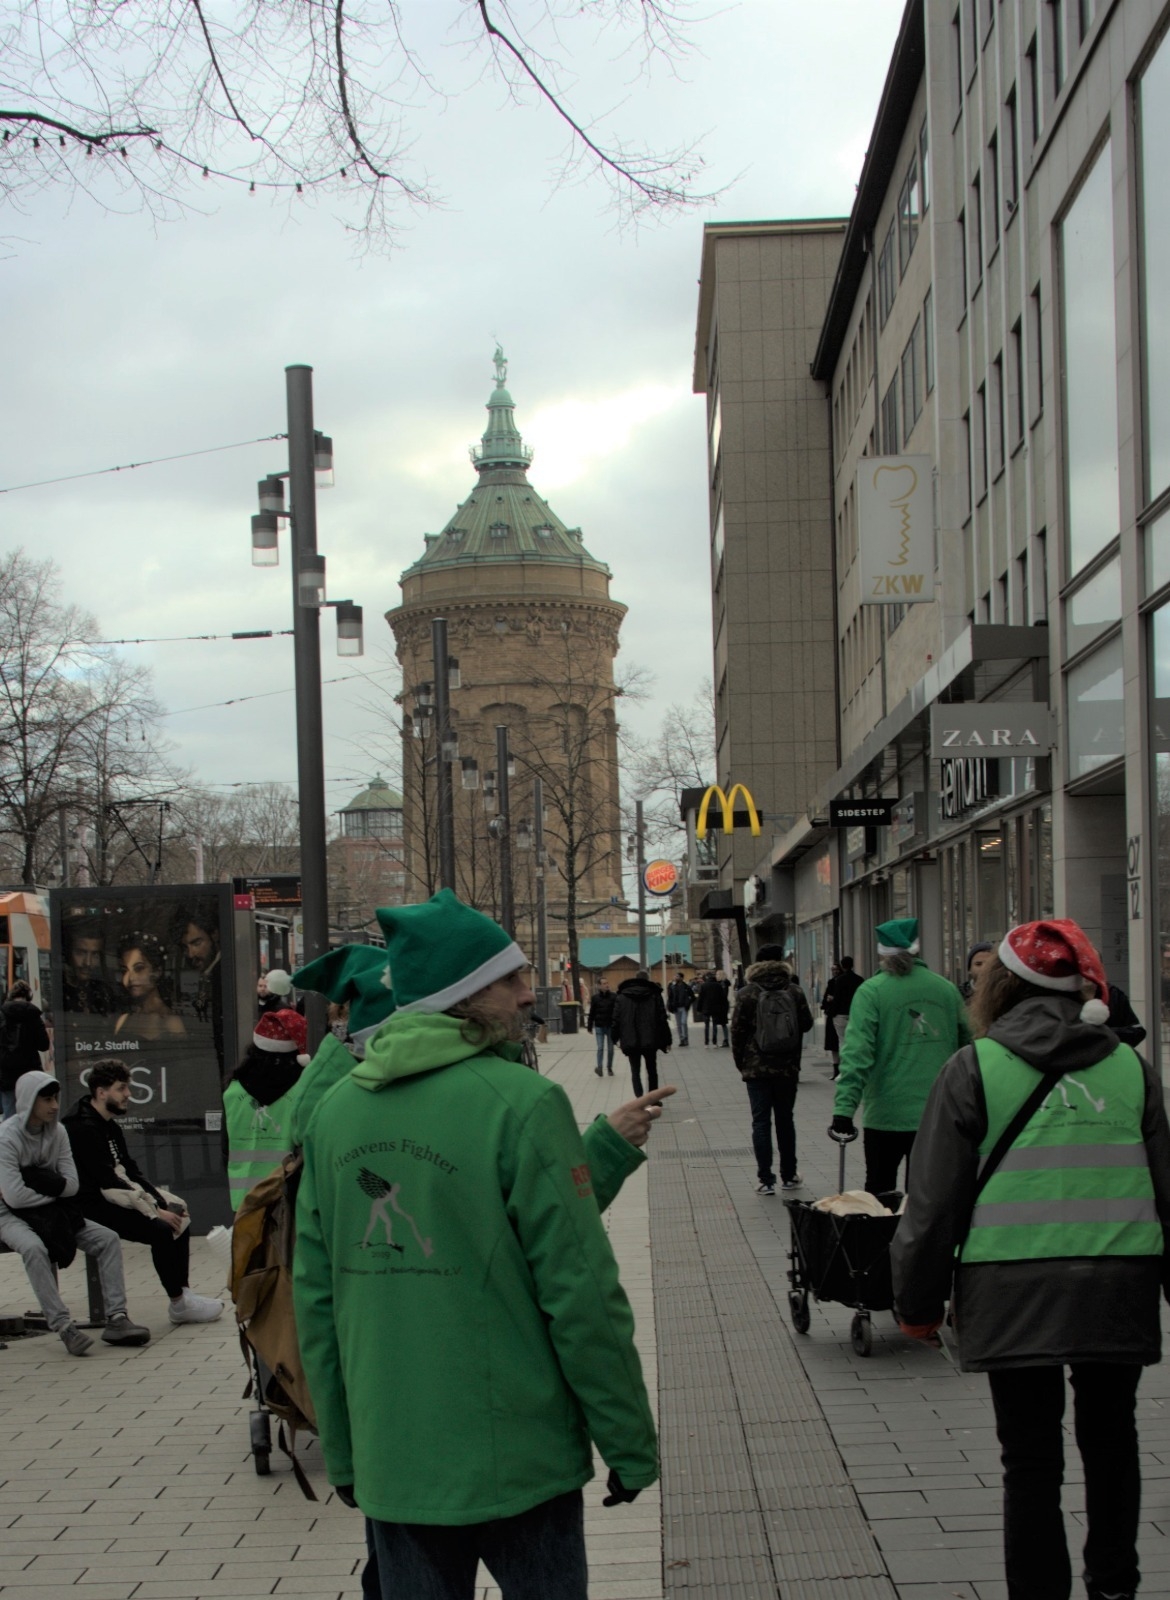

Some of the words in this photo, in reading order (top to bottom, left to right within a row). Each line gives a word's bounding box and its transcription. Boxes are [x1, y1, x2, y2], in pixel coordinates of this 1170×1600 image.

[872, 574, 924, 595] ZKW
[942, 729, 1039, 747] ZARA
[837, 808, 885, 817] SIDESTEP
[646, 863, 674, 880] BURGER
[648, 871, 676, 889] KING
[1131, 881, 1140, 919] 12
[74, 1041, 92, 1051] Die
[94, 1041, 104, 1051] 2.
[105, 1040, 140, 1051] Staffel
[334, 1140, 397, 1172] Heavens
[400, 1138, 459, 1175] Fighter
